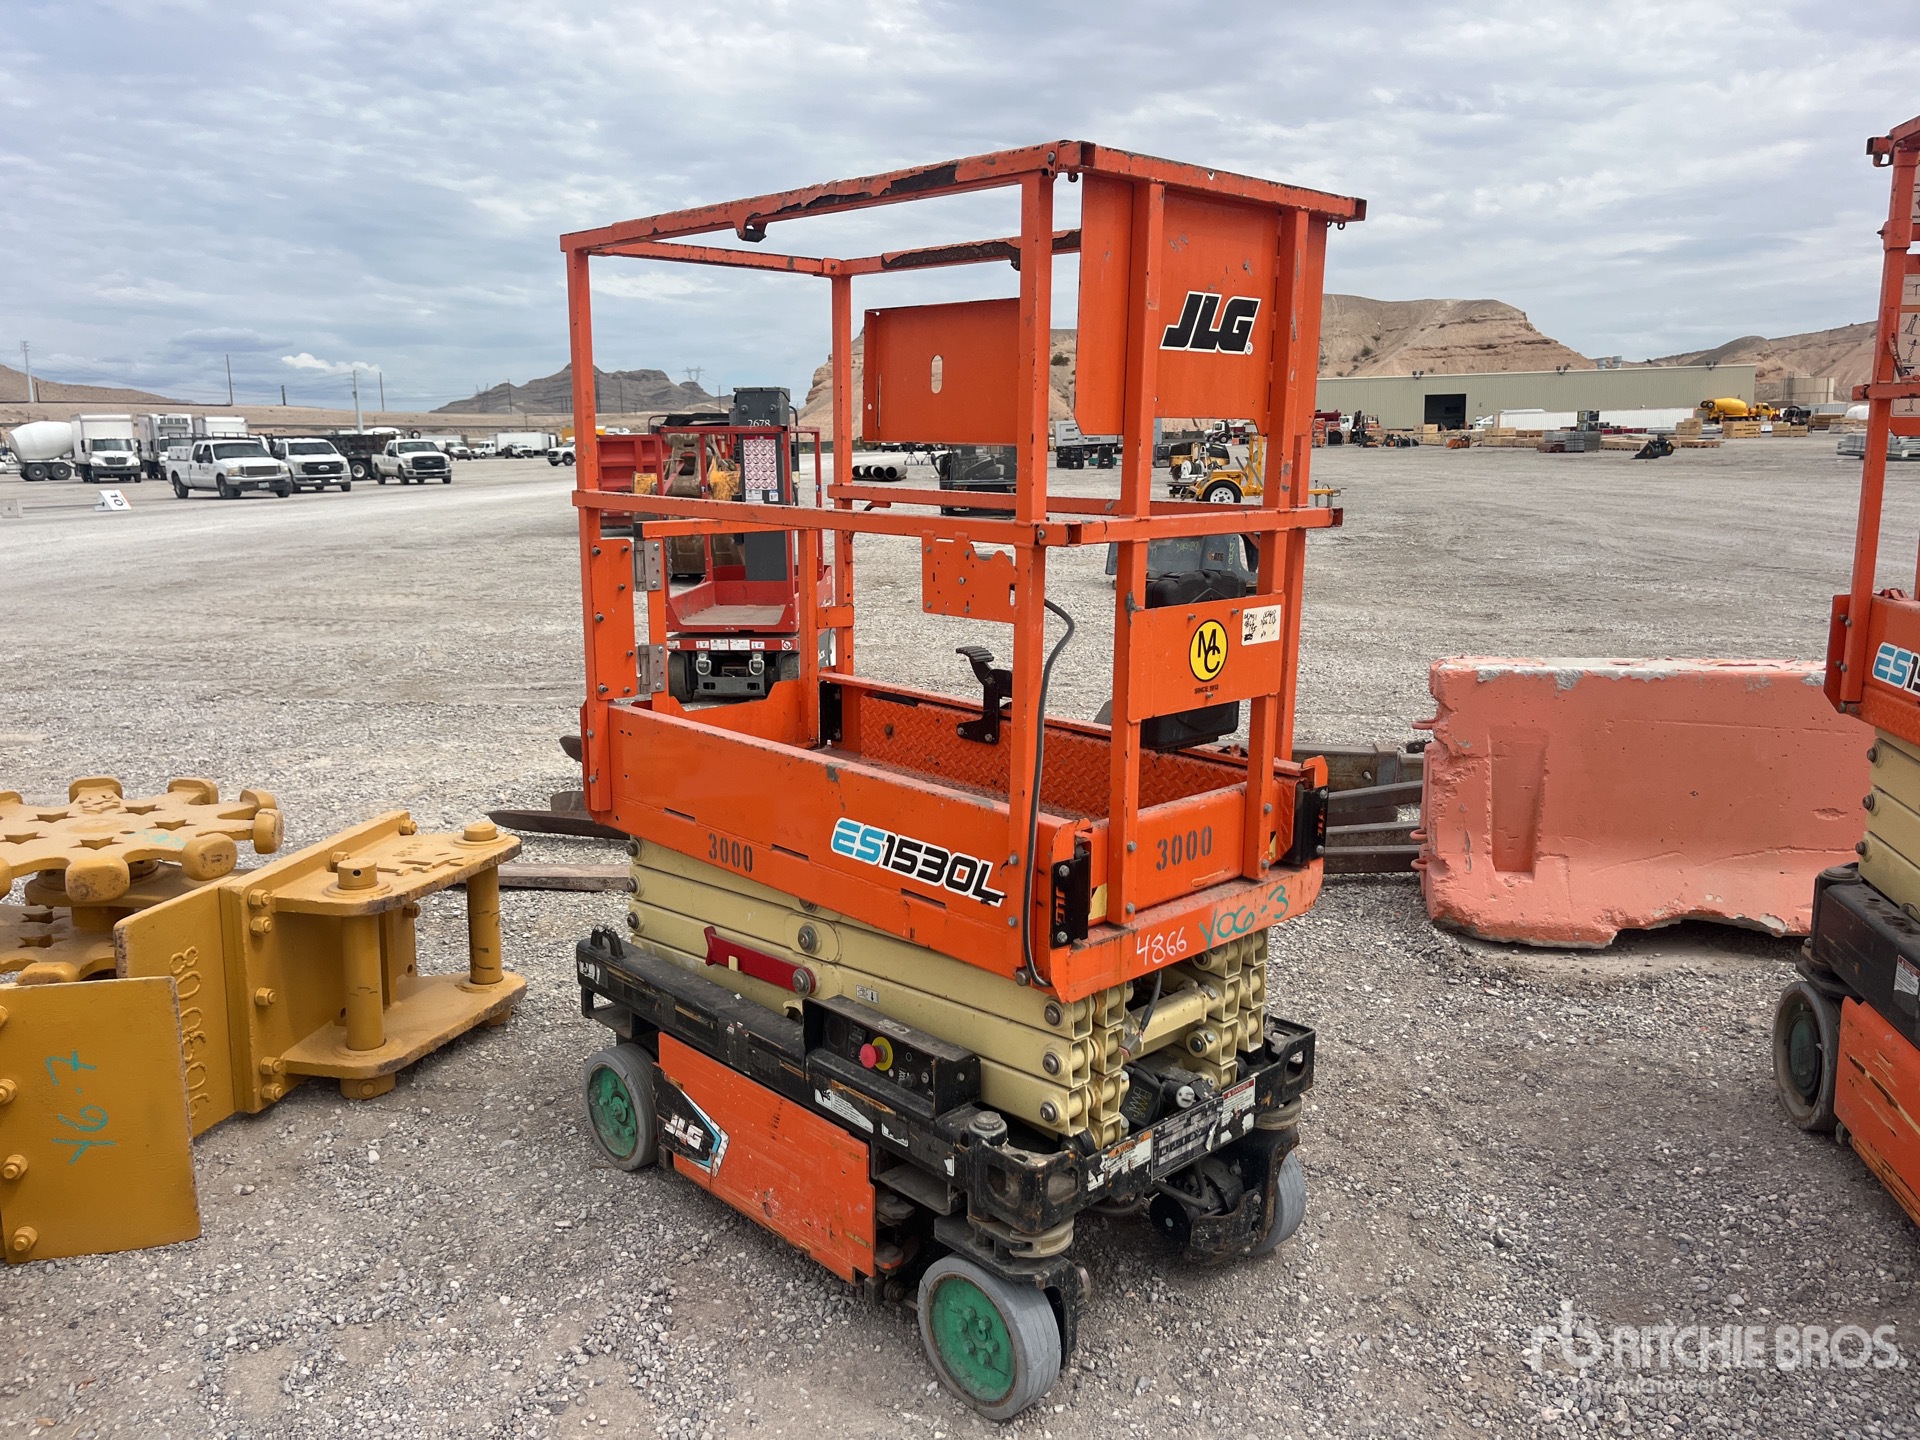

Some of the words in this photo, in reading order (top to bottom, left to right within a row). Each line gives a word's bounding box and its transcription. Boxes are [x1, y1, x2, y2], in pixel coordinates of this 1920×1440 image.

[1160, 290, 1261, 354] JLG
[110, 493, 124, 507] 10
[708, 833, 753, 873] 3000
[831, 817, 1007, 907] ES1530L
[1156, 826, 1213, 871] 3000
[1055, 886, 1067, 926] JLG
[1136, 926, 1187, 966] 4866
[664, 1113, 704, 1150] JLG
